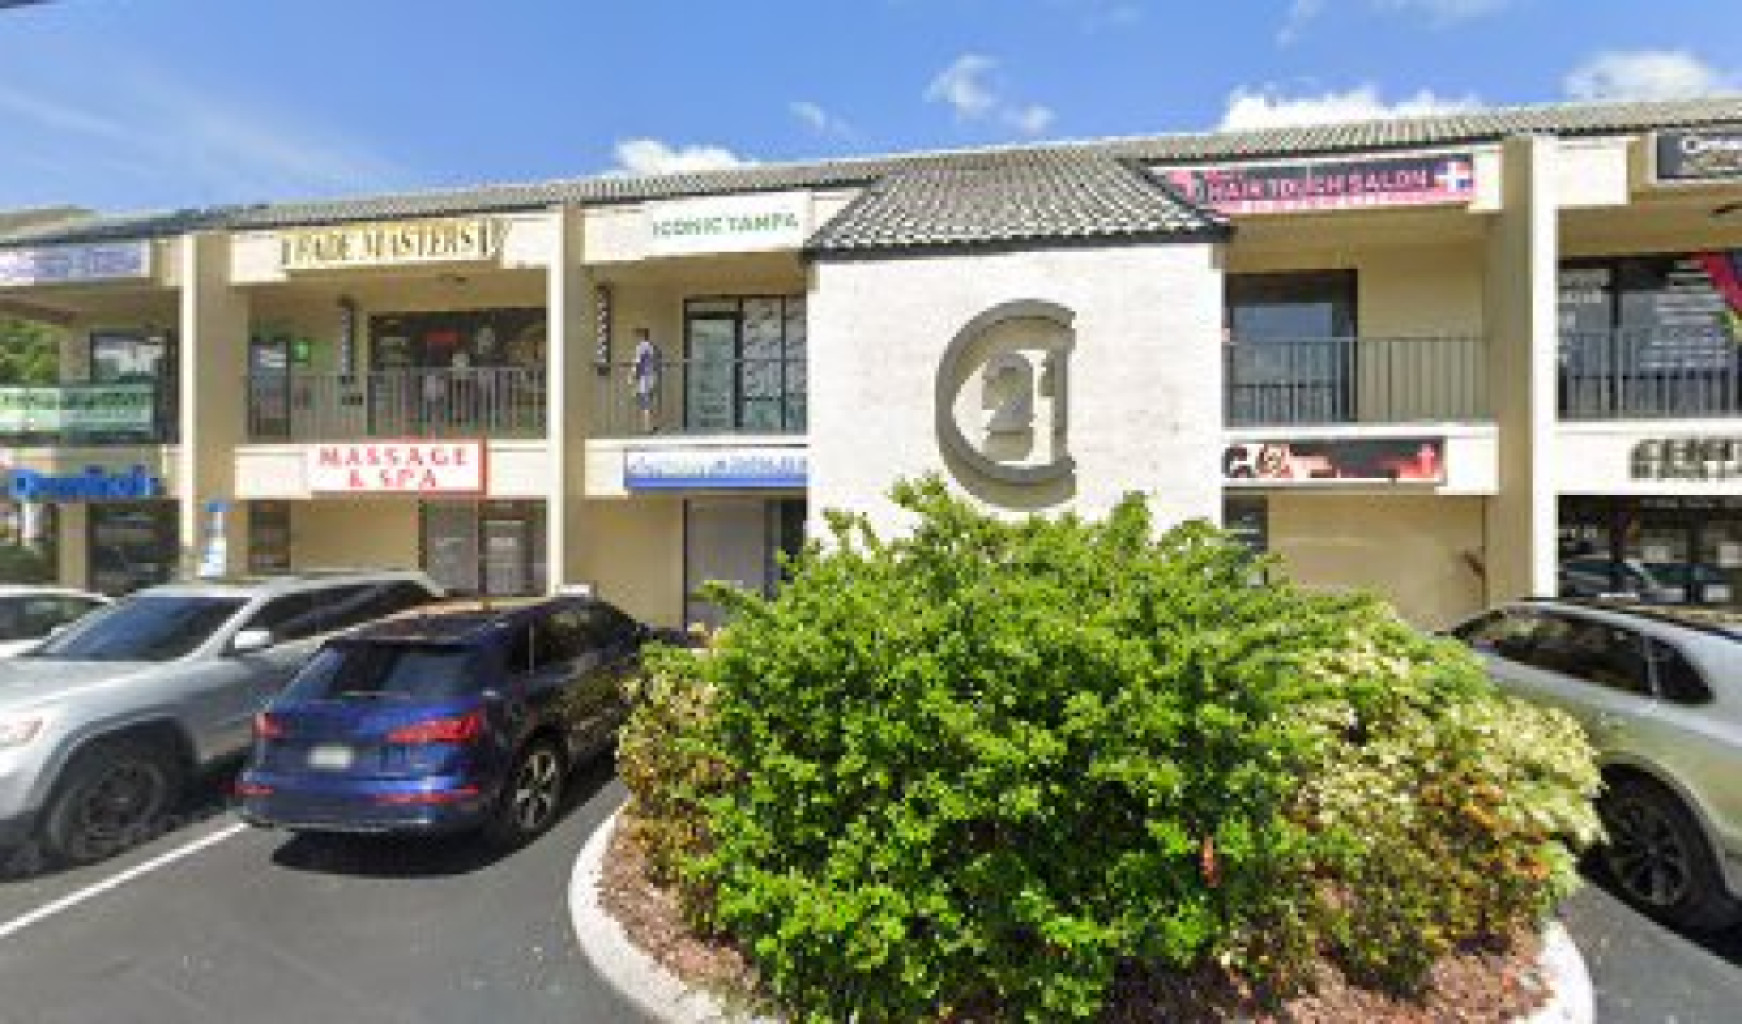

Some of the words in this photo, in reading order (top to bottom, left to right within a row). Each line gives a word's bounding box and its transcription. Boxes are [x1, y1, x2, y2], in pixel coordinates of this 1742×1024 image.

[1347, 168, 1430, 192] SALON
[652, 216, 722, 237] ICONIC
[727, 211, 800, 232] TAMPA
[318, 446, 470, 466] MASSAGE
[378, 468, 437, 488] SPA
